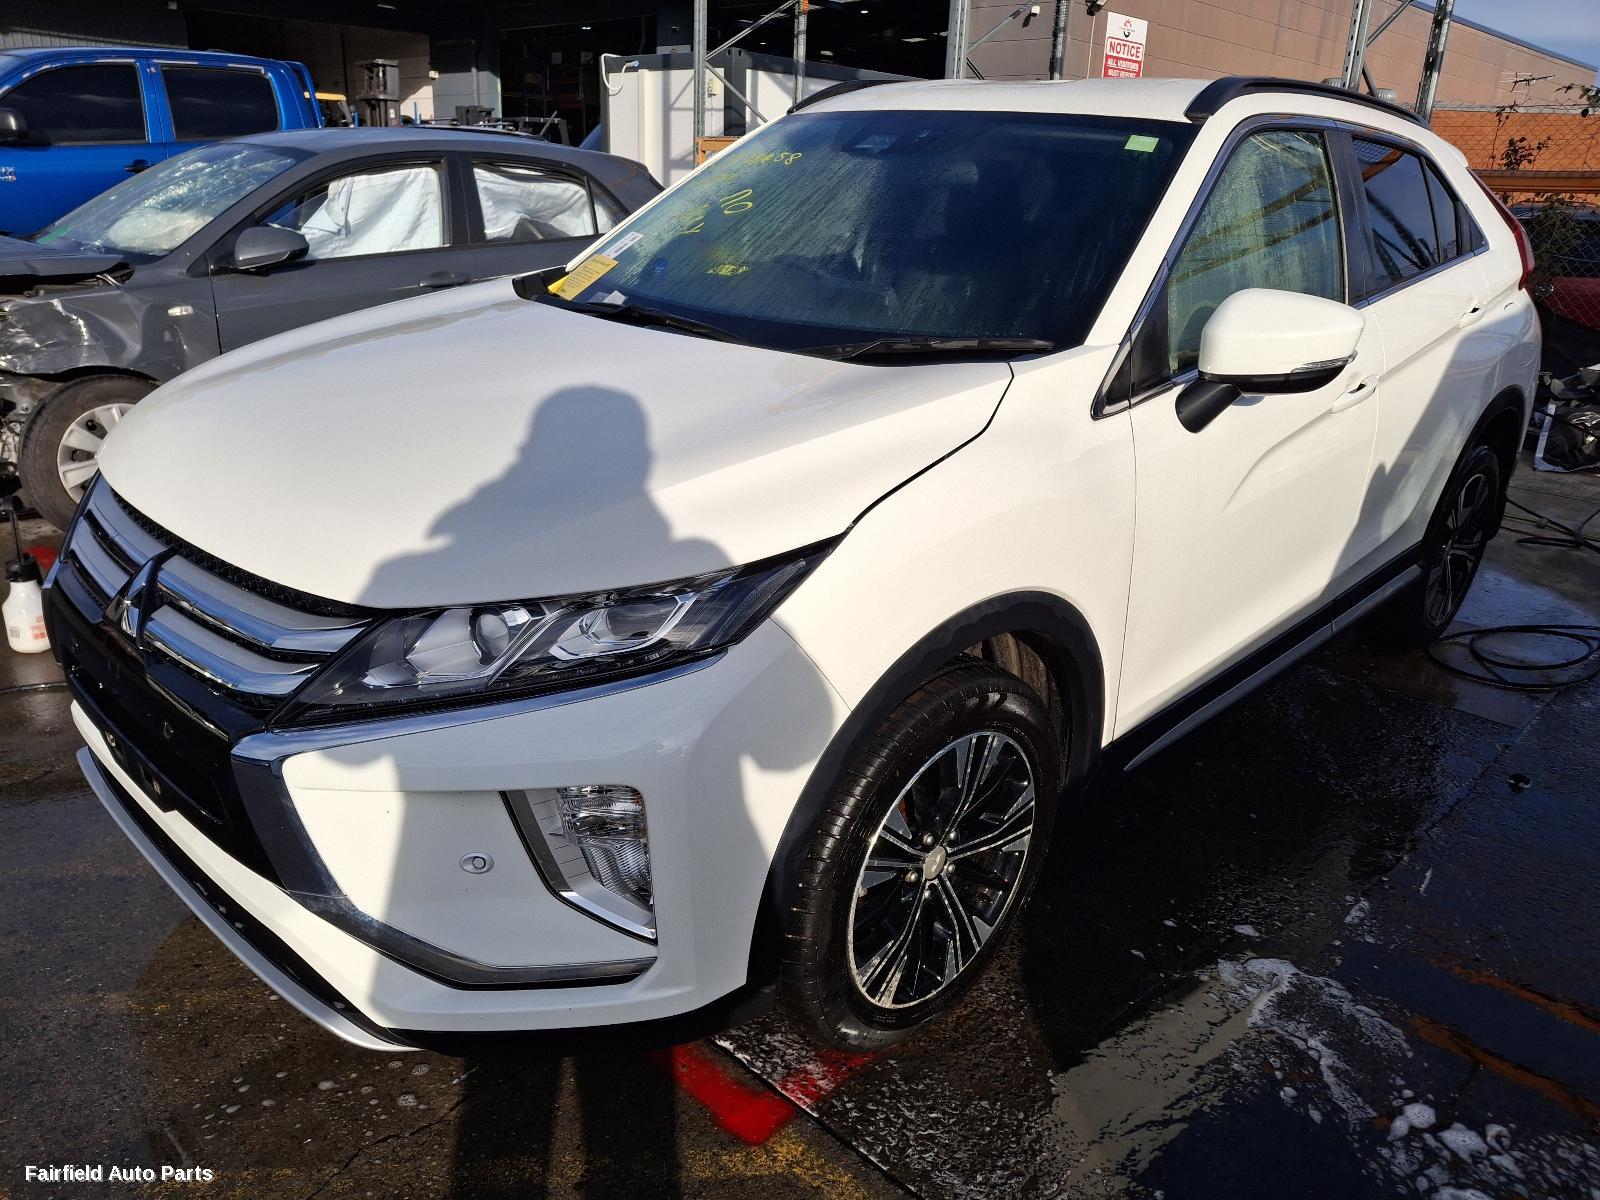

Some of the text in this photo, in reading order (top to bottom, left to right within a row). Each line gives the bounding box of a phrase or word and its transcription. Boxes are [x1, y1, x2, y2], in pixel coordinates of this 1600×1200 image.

[1109, 41, 1141, 58] NOTICE
[1107, 58, 1139, 71] ALL VISITORS
